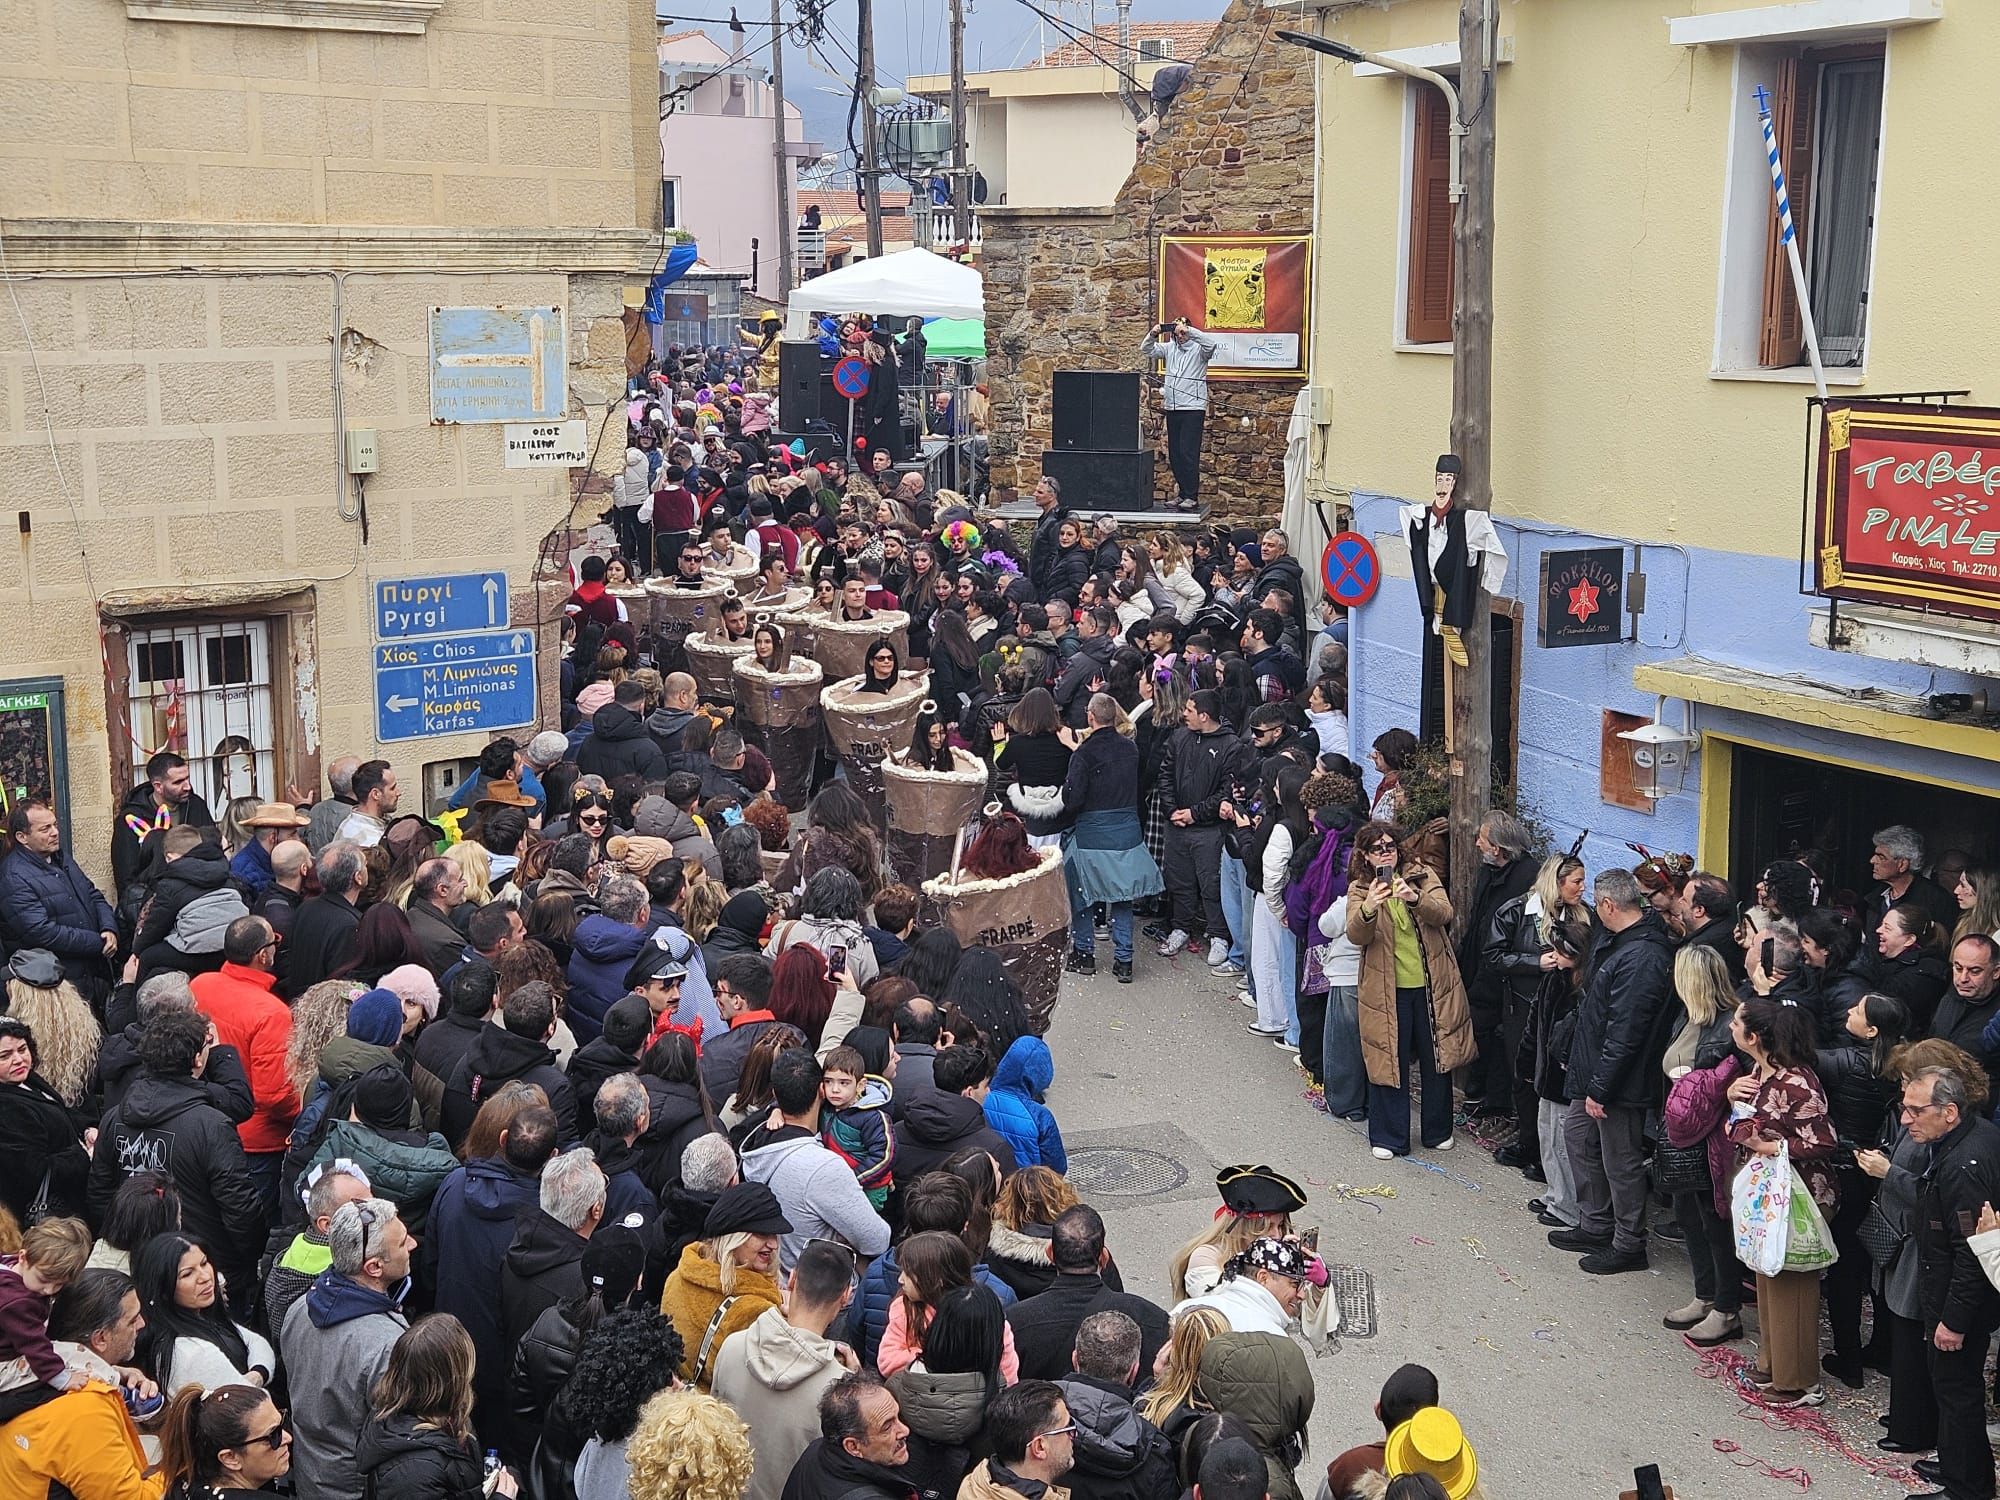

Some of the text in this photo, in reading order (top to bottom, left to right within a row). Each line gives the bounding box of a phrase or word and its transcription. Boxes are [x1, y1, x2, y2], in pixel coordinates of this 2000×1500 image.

[532, 427, 560, 436] ΟΔΟΣ
[1862, 508, 2000, 555] PINALE
[1928, 556, 1946, 573] Χίος
[1952, 559, 1970, 575] Τηλ:
[1972, 562, 1998, 577] 22710
[383, 582, 452, 604] Πυργί
[384, 606, 445, 630] Pyrgi
[382, 648, 418, 664] Χίος
[433, 643, 476, 659] Chios
[443, 662, 518, 682] Λιμνιώνας
[444, 679, 516, 697] Limnionas
[425, 696, 481, 716] Καρφάς
[425, 716, 475, 731] Karfas
[980, 915, 1034, 945] FRAPPÉ
